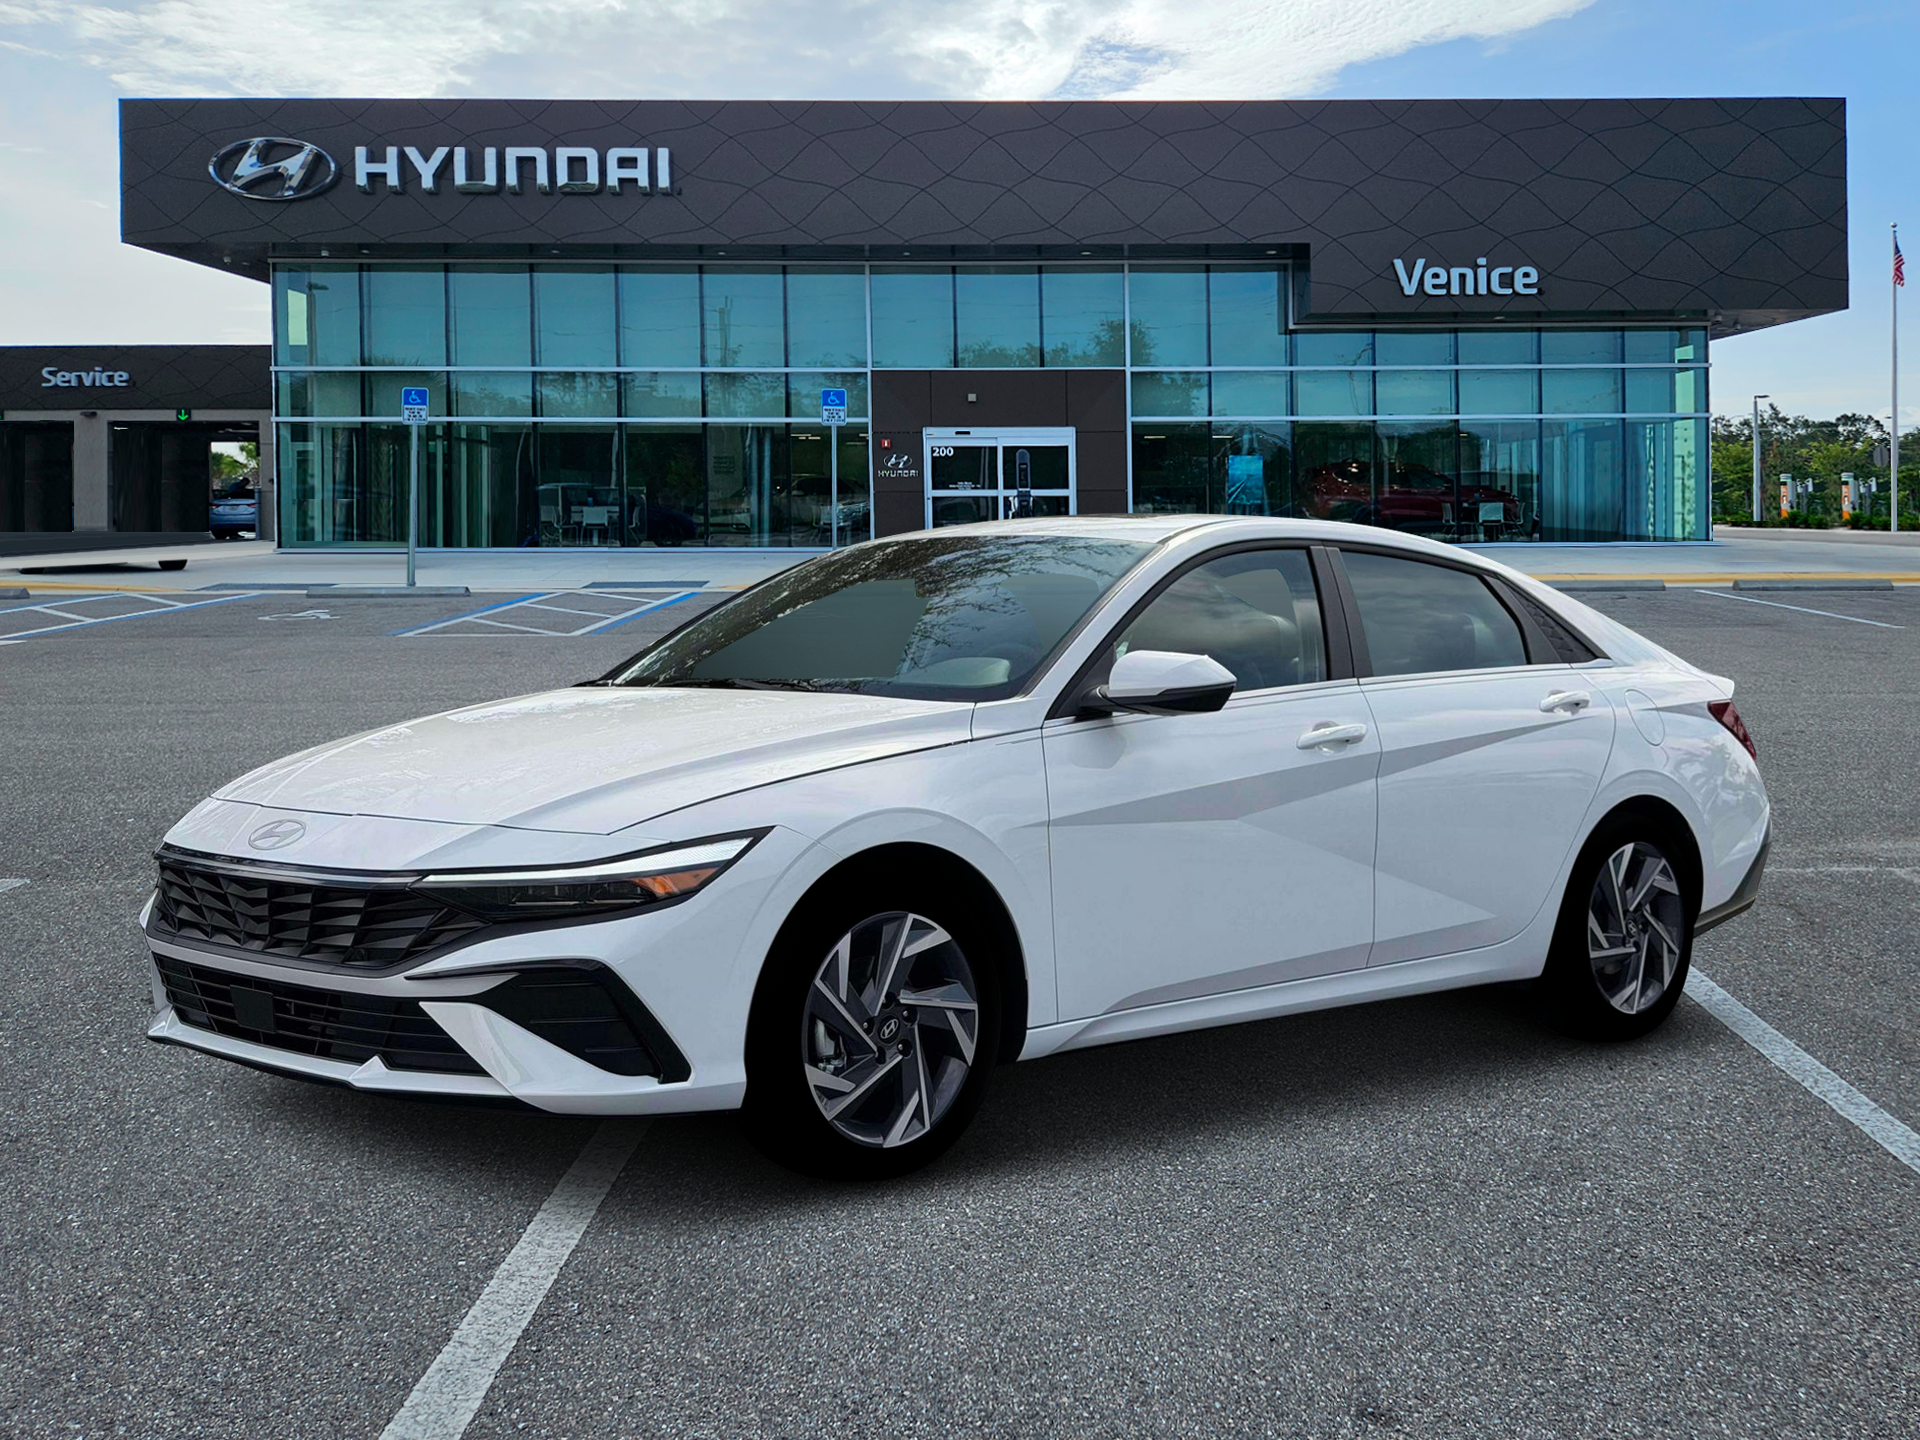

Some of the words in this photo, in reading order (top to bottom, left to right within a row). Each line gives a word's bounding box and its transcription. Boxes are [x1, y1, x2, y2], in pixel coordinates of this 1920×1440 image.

[354, 145, 671, 195] HYUNDAI
[1392, 256, 1540, 297] Venice
[41, 366, 131, 388] Service
[932, 446, 954, 457] 200
[877, 469, 919, 478] HYUNDAI
